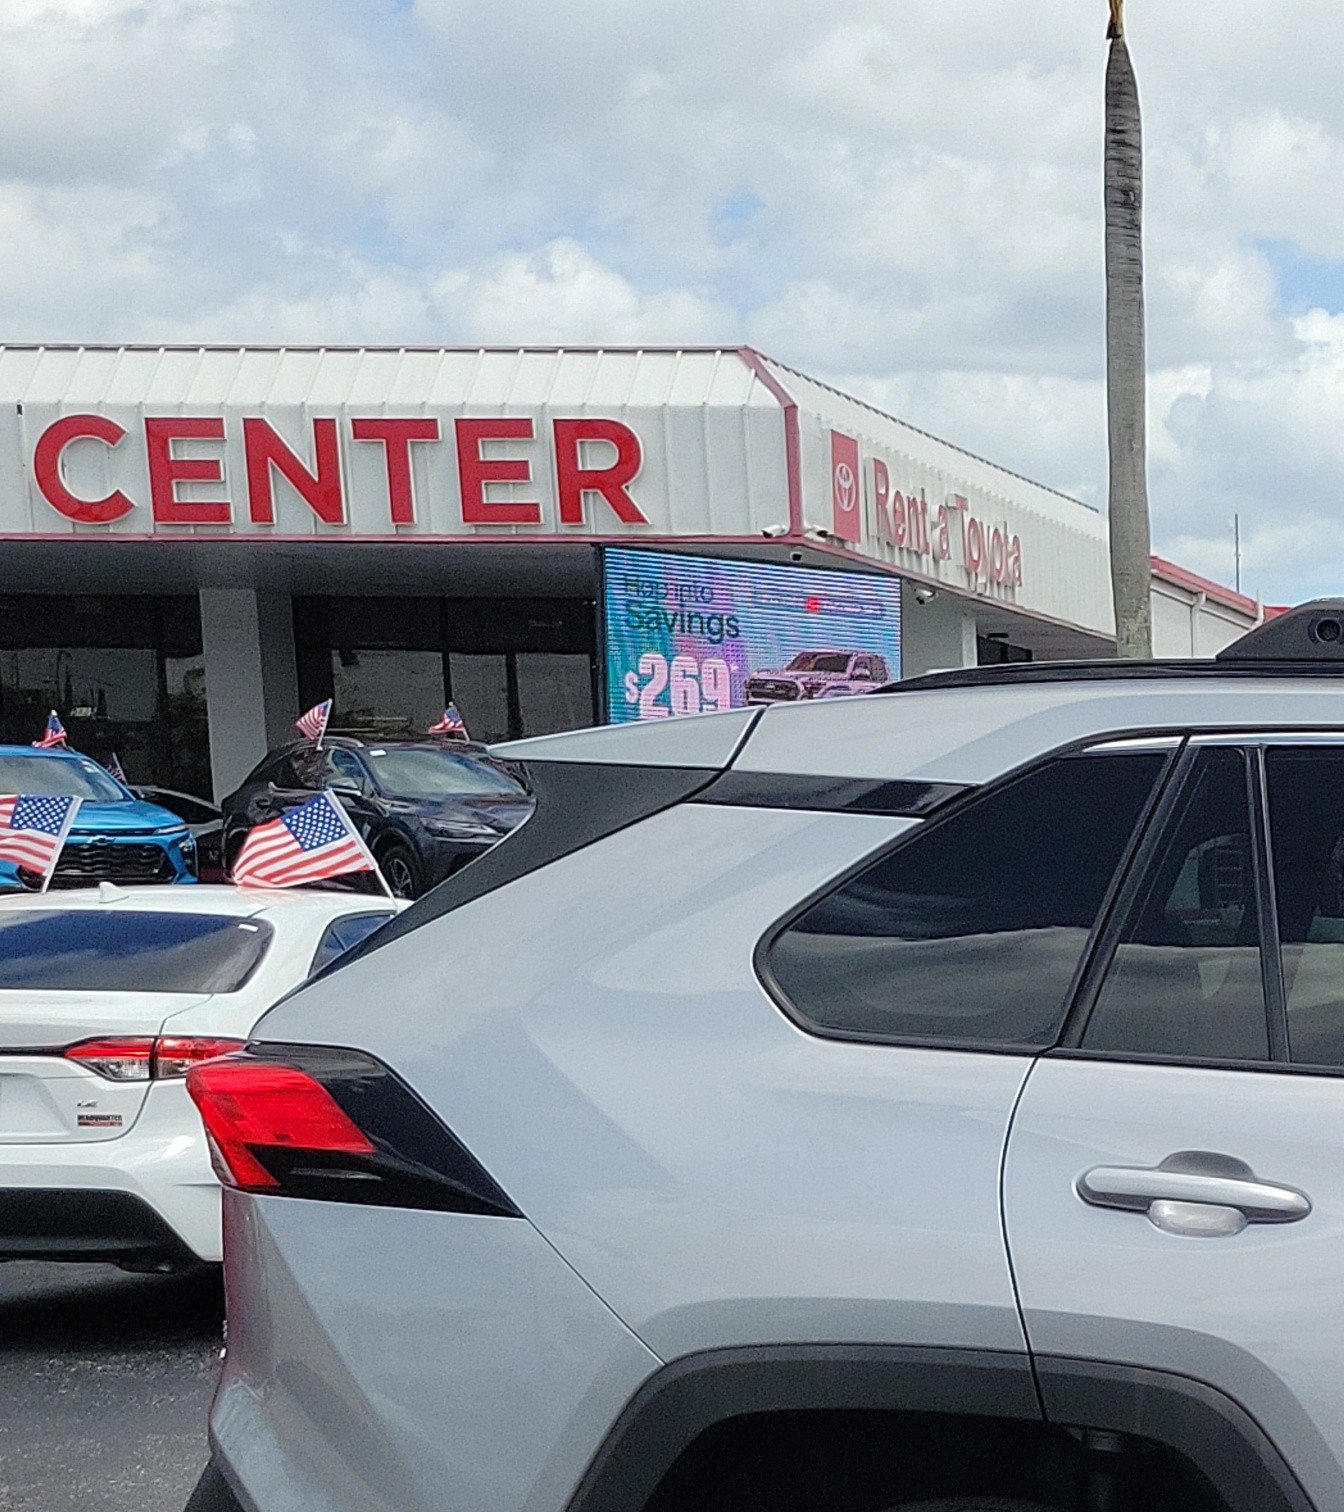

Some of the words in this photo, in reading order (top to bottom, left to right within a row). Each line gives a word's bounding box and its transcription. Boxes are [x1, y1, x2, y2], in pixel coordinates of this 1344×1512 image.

[33, 413, 653, 525] CENTER
[866, 457, 931, 556] Rent
[946, 493, 1023, 588] Toyota
[625, 601, 740, 645] Savings
[624, 652, 731, 720] $269
